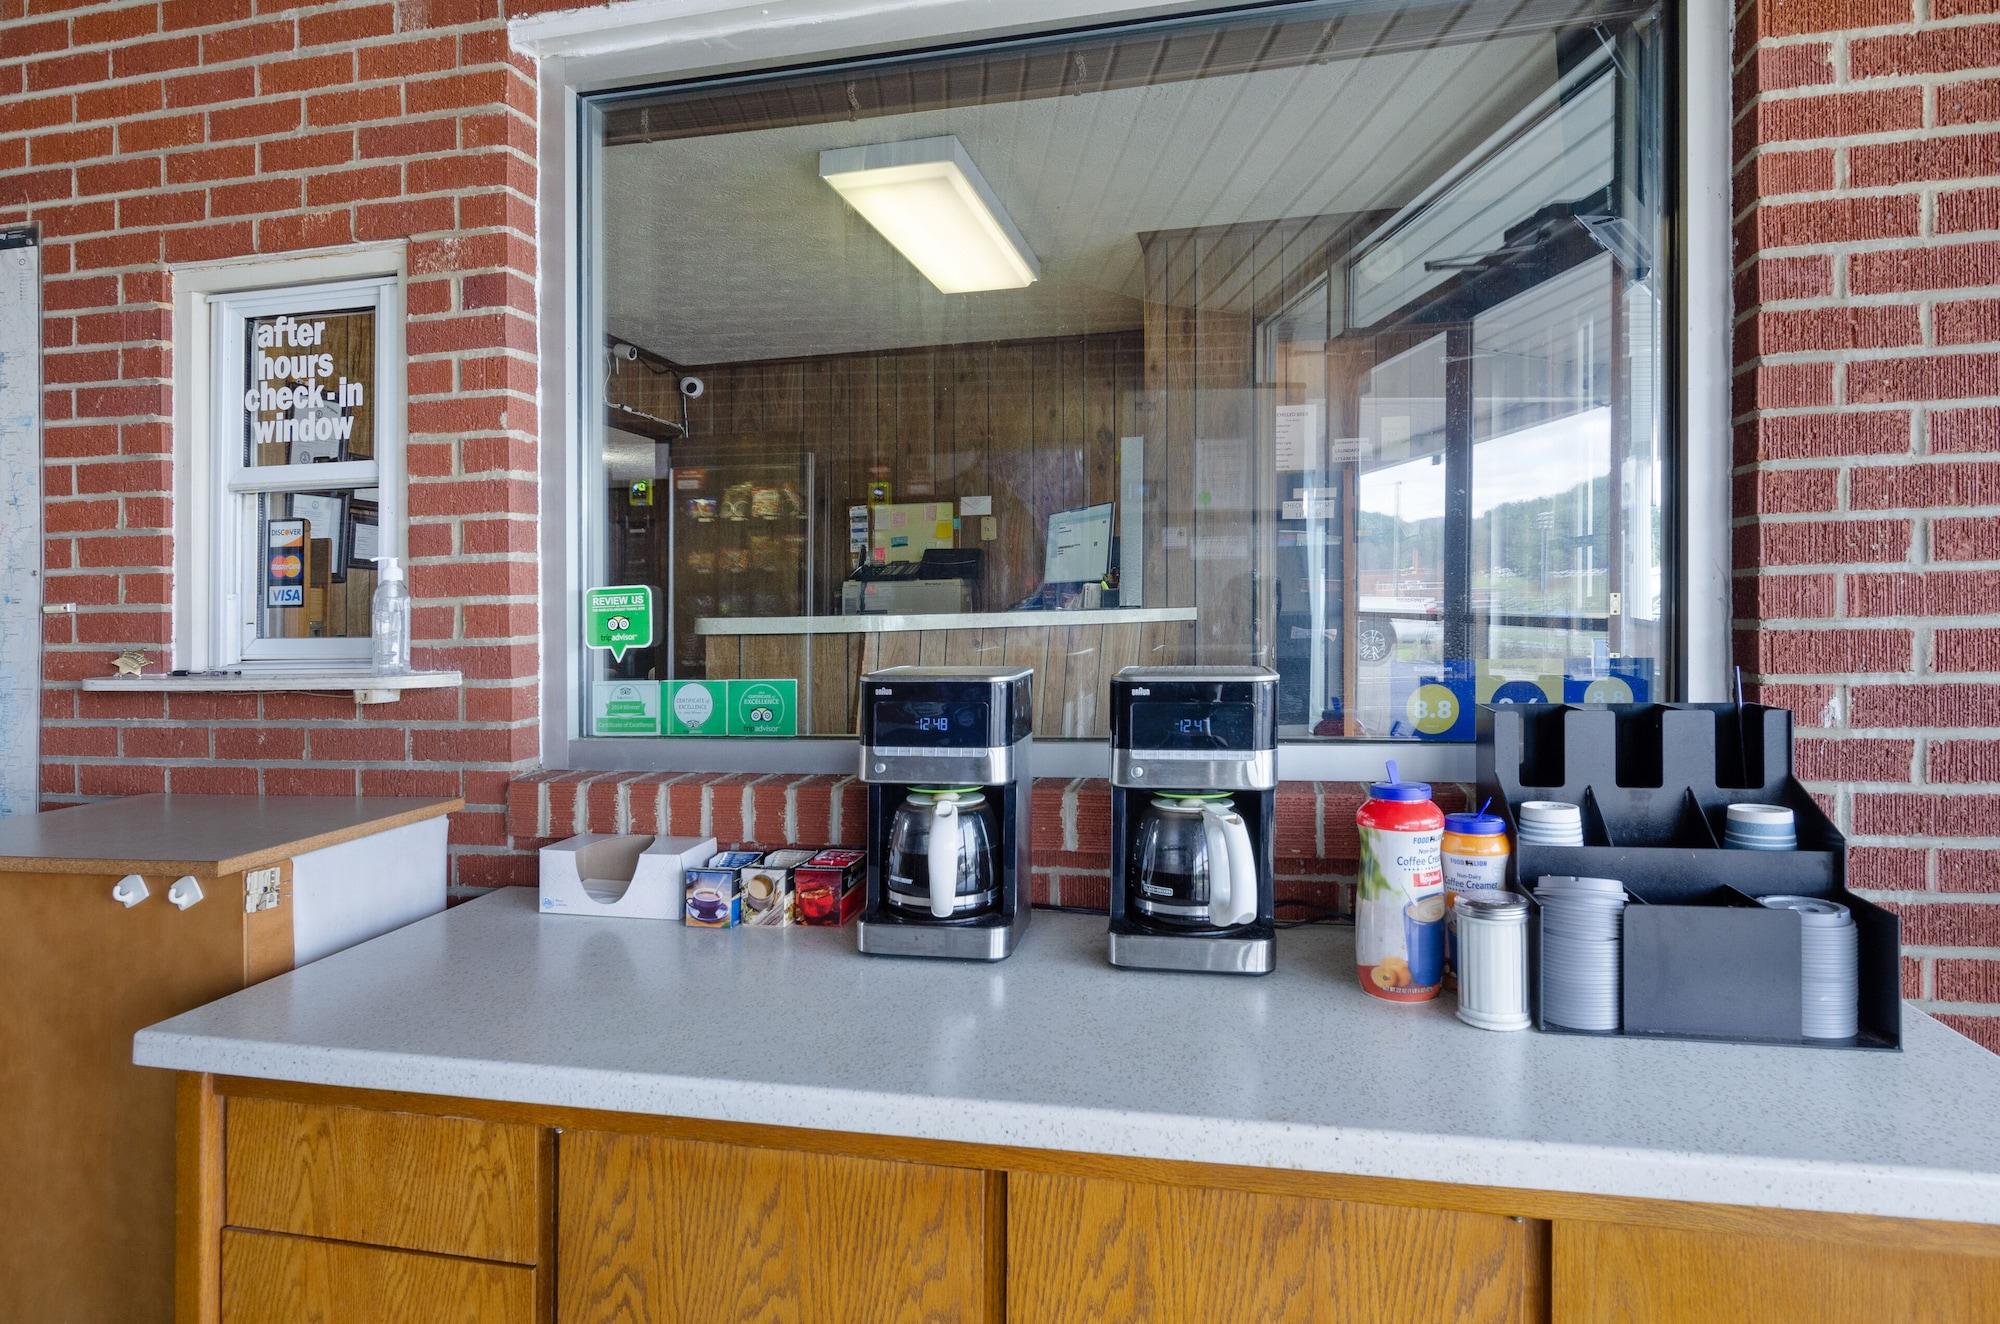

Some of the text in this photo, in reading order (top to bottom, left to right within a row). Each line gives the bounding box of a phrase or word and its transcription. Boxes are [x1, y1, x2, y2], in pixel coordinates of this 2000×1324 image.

[258, 315, 326, 348] after
[258, 349, 334, 381] hours
[244, 376, 364, 412] check-in
[253, 411, 355, 444] window
[271, 528, 302, 536] DISCOVER
[273, 589, 301, 602] VISA
[592, 595, 644, 606] REVIEW US
[600, 633, 635, 642] tripadvisor
[874, 687, 893, 696] BRAUN
[1131, 687, 1151, 696] BRAUN
[1414, 700, 1452, 719] 8.8
[1397, 856, 1426, 866] Coffee
